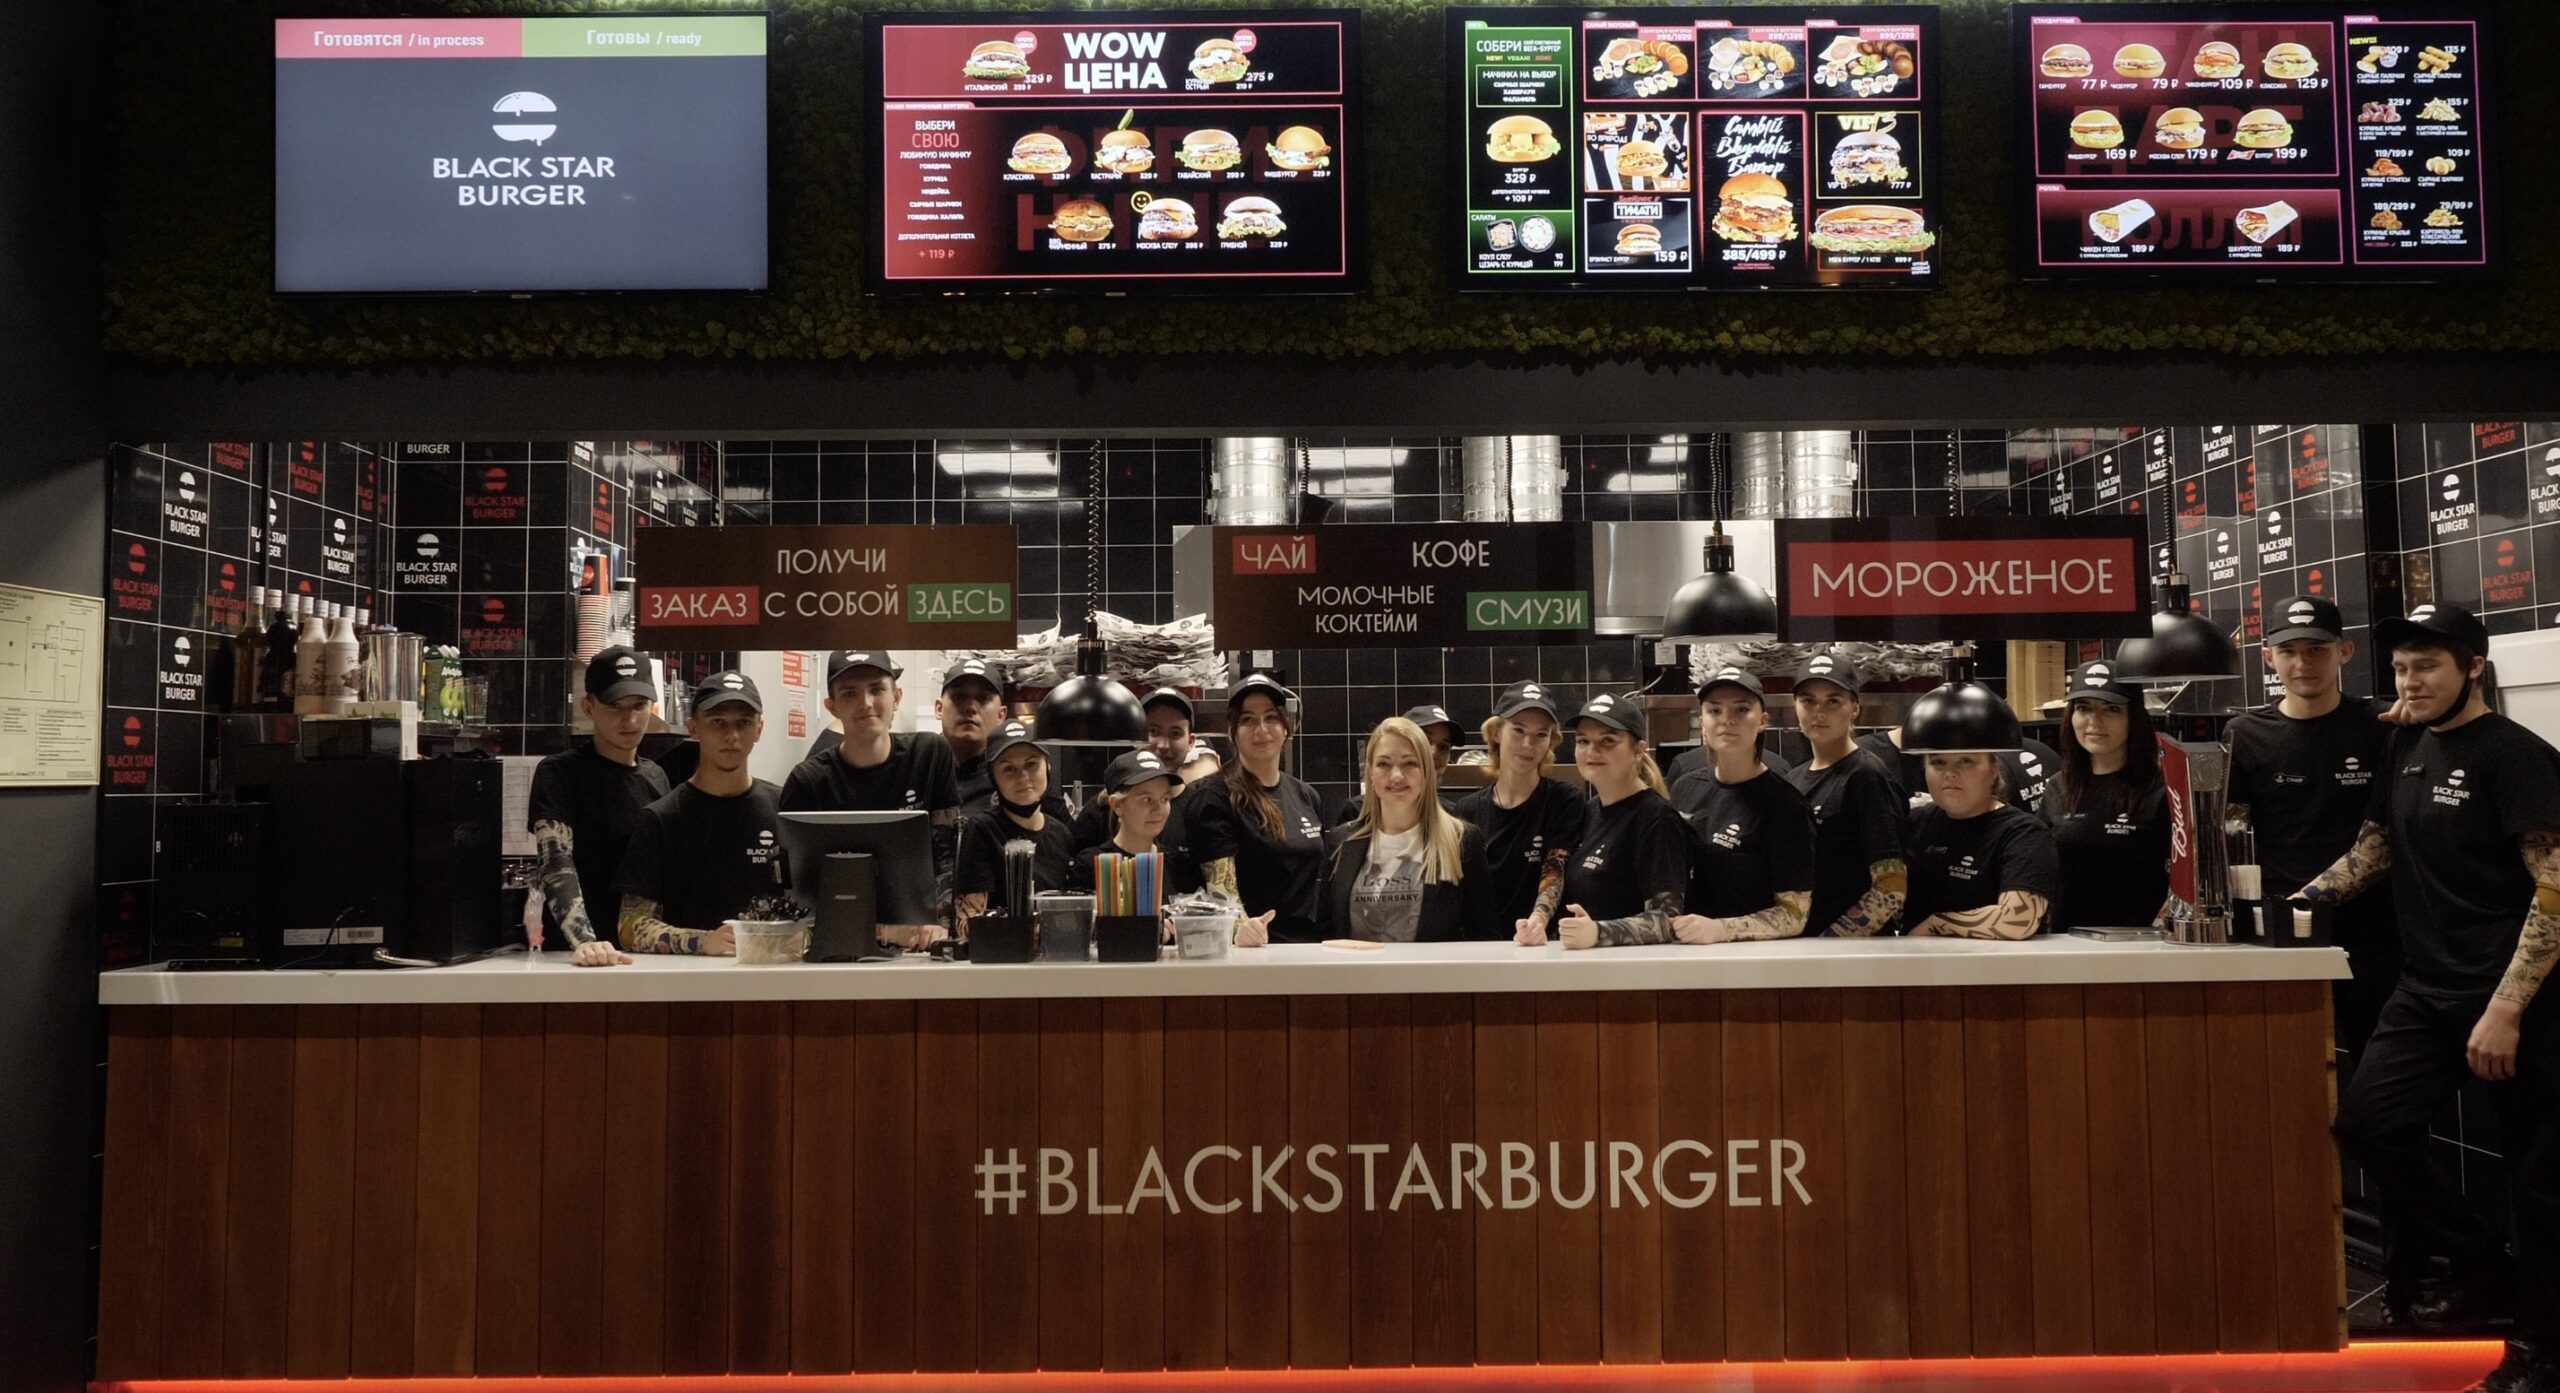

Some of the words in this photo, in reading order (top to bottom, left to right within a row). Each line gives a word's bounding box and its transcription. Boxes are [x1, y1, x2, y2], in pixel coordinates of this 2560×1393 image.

[417, 34, 431, 46] in
[433, 35, 485, 49] process
[665, 32, 702, 46] ready
[1063, 31, 1167, 60] WOW
[1476, 40, 1522, 53] СОБЕРИ
[1064, 62, 1168, 94] ЦЕНА
[1482, 70, 1518, 79] НАЧИНКА
[1531, 70, 1557, 79] ВЫБОР
[2081, 79, 2097, 89] 77
[2152, 79, 2169, 89] 79
[2220, 79, 2243, 89] 109
[2296, 78, 2318, 89] 129
[914, 120, 955, 131] ВЫБЕРИ
[911, 133, 960, 148] СВОЮ
[899, 151, 938, 159] ЛЮБИМУЮ
[938, 151, 972, 159] НАЧИНКУ
[2104, 148, 2127, 160] 169
[2186, 148, 2208, 159] 179
[2275, 148, 2297, 159] 199
[432, 157, 532, 178] BLACK
[541, 156, 615, 178] STAR
[1504, 173, 1527, 184] 329
[458, 184, 586, 206] BURGER
[1511, 195, 1527, 203] 109
[1618, 205, 1659, 216] ТИМАТИ
[928, 249, 945, 259] 119
[2131, 244, 2147, 253] 189
[2277, 244, 2293, 252] 189
[1653, 251, 1677, 263] 159
[1722, 249, 1777, 261] 385/499
[2481, 430, 2516, 449] BURGER
[407, 443, 450, 455] BURGER
[2530, 483, 2560, 500] BLACK
[464, 496, 496, 506] BLACK
[500, 496, 526, 506] STAR
[165, 502, 189, 518] BLACK
[190, 509, 208, 524] STAR
[472, 508, 516, 519] BURGER
[2430, 506, 2455, 522] BLACK
[2455, 503, 2475, 518] STAR
[170, 519, 200, 538] BURGER
[2436, 518, 2469, 535] BURGER
[2258, 539, 2276, 554] BLACK
[2276, 536, 2293, 550] STAR
[1240, 535, 1307, 571] ЧАЙ
[1412, 539, 1491, 568] КОФЕ
[2263, 550, 2288, 564] BURGER
[396, 562, 429, 573] BLACK
[432, 562, 458, 573] STAR
[777, 548, 886, 575] ПОЛУЧИ
[404, 574, 448, 585] BURGER
[1813, 558, 2113, 598] МОРОЖЕНОЕ
[2483, 576, 2510, 589] BLACK
[2510, 571, 2531, 584] STAR
[1298, 585, 1435, 607] МОЛОЧНЫЕ
[2489, 586, 2524, 603] BURGER
[651, 592, 748, 619] ЗАКАЗ
[764, 592, 786, 618] С
[796, 583, 899, 618] СОБОЙ
[915, 588, 1006, 620] ЗДЕСЬ
[1475, 598, 1582, 626] СМУЗИ
[1315, 608, 1418, 634] КОКТЕЙЛИ
[463, 628, 493, 639] BLACK
[497, 628, 524, 639] STAR
[470, 639, 513, 650] BURGER
[160, 671, 183, 686] BLACK
[184, 673, 203, 687] STAR
[165, 687, 196, 700] BURGER
[2452, 788, 2471, 800] STAR
[2433, 795, 2461, 807] BURGER
[2171, 785, 2188, 863] Bud
[974, 1139, 1814, 1217] #BLACKSTARBURGER
